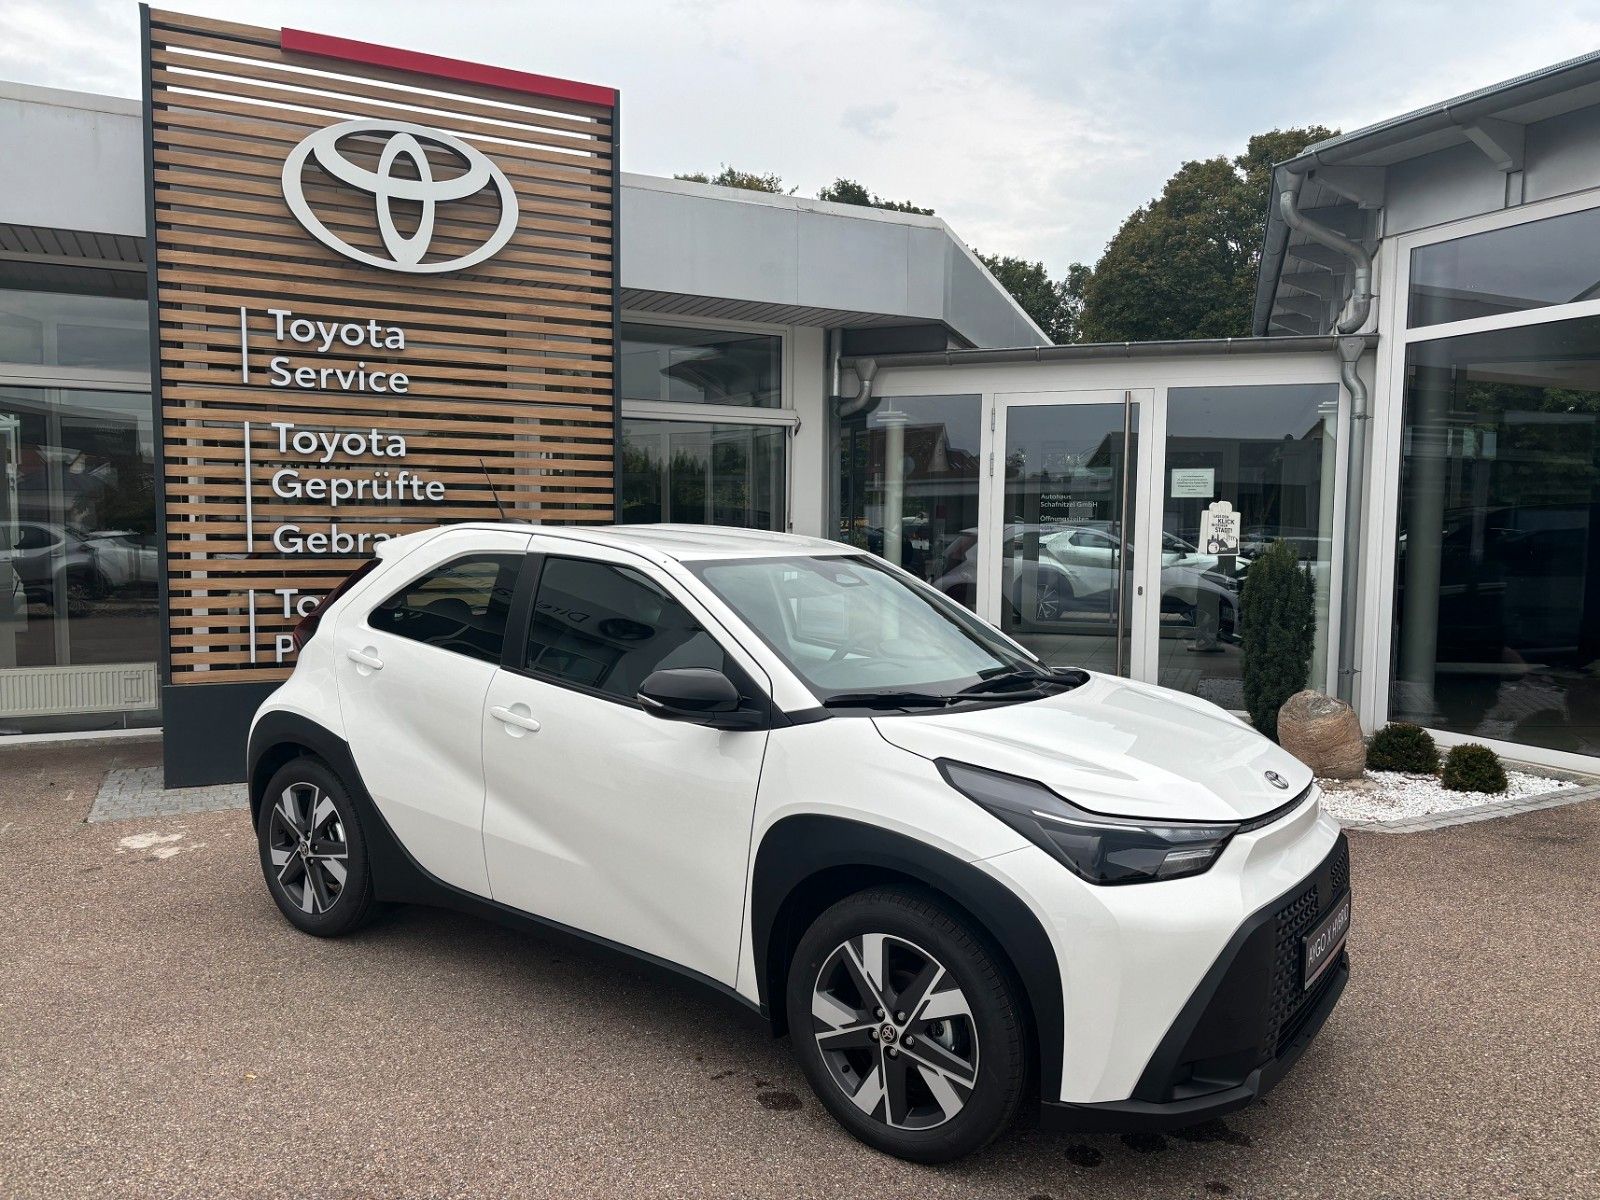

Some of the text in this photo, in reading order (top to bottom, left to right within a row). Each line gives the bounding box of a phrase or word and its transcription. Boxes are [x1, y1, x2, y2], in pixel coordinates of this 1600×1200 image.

[267, 308, 406, 353] Toyota
[270, 356, 410, 393] Service
[271, 422, 407, 463] Toyota
[272, 469, 446, 507] Geprüfte
[273, 523, 402, 554] Gebra
[274, 588, 326, 619] To
[1308, 903, 1348, 967] AYGO X HYBRID
